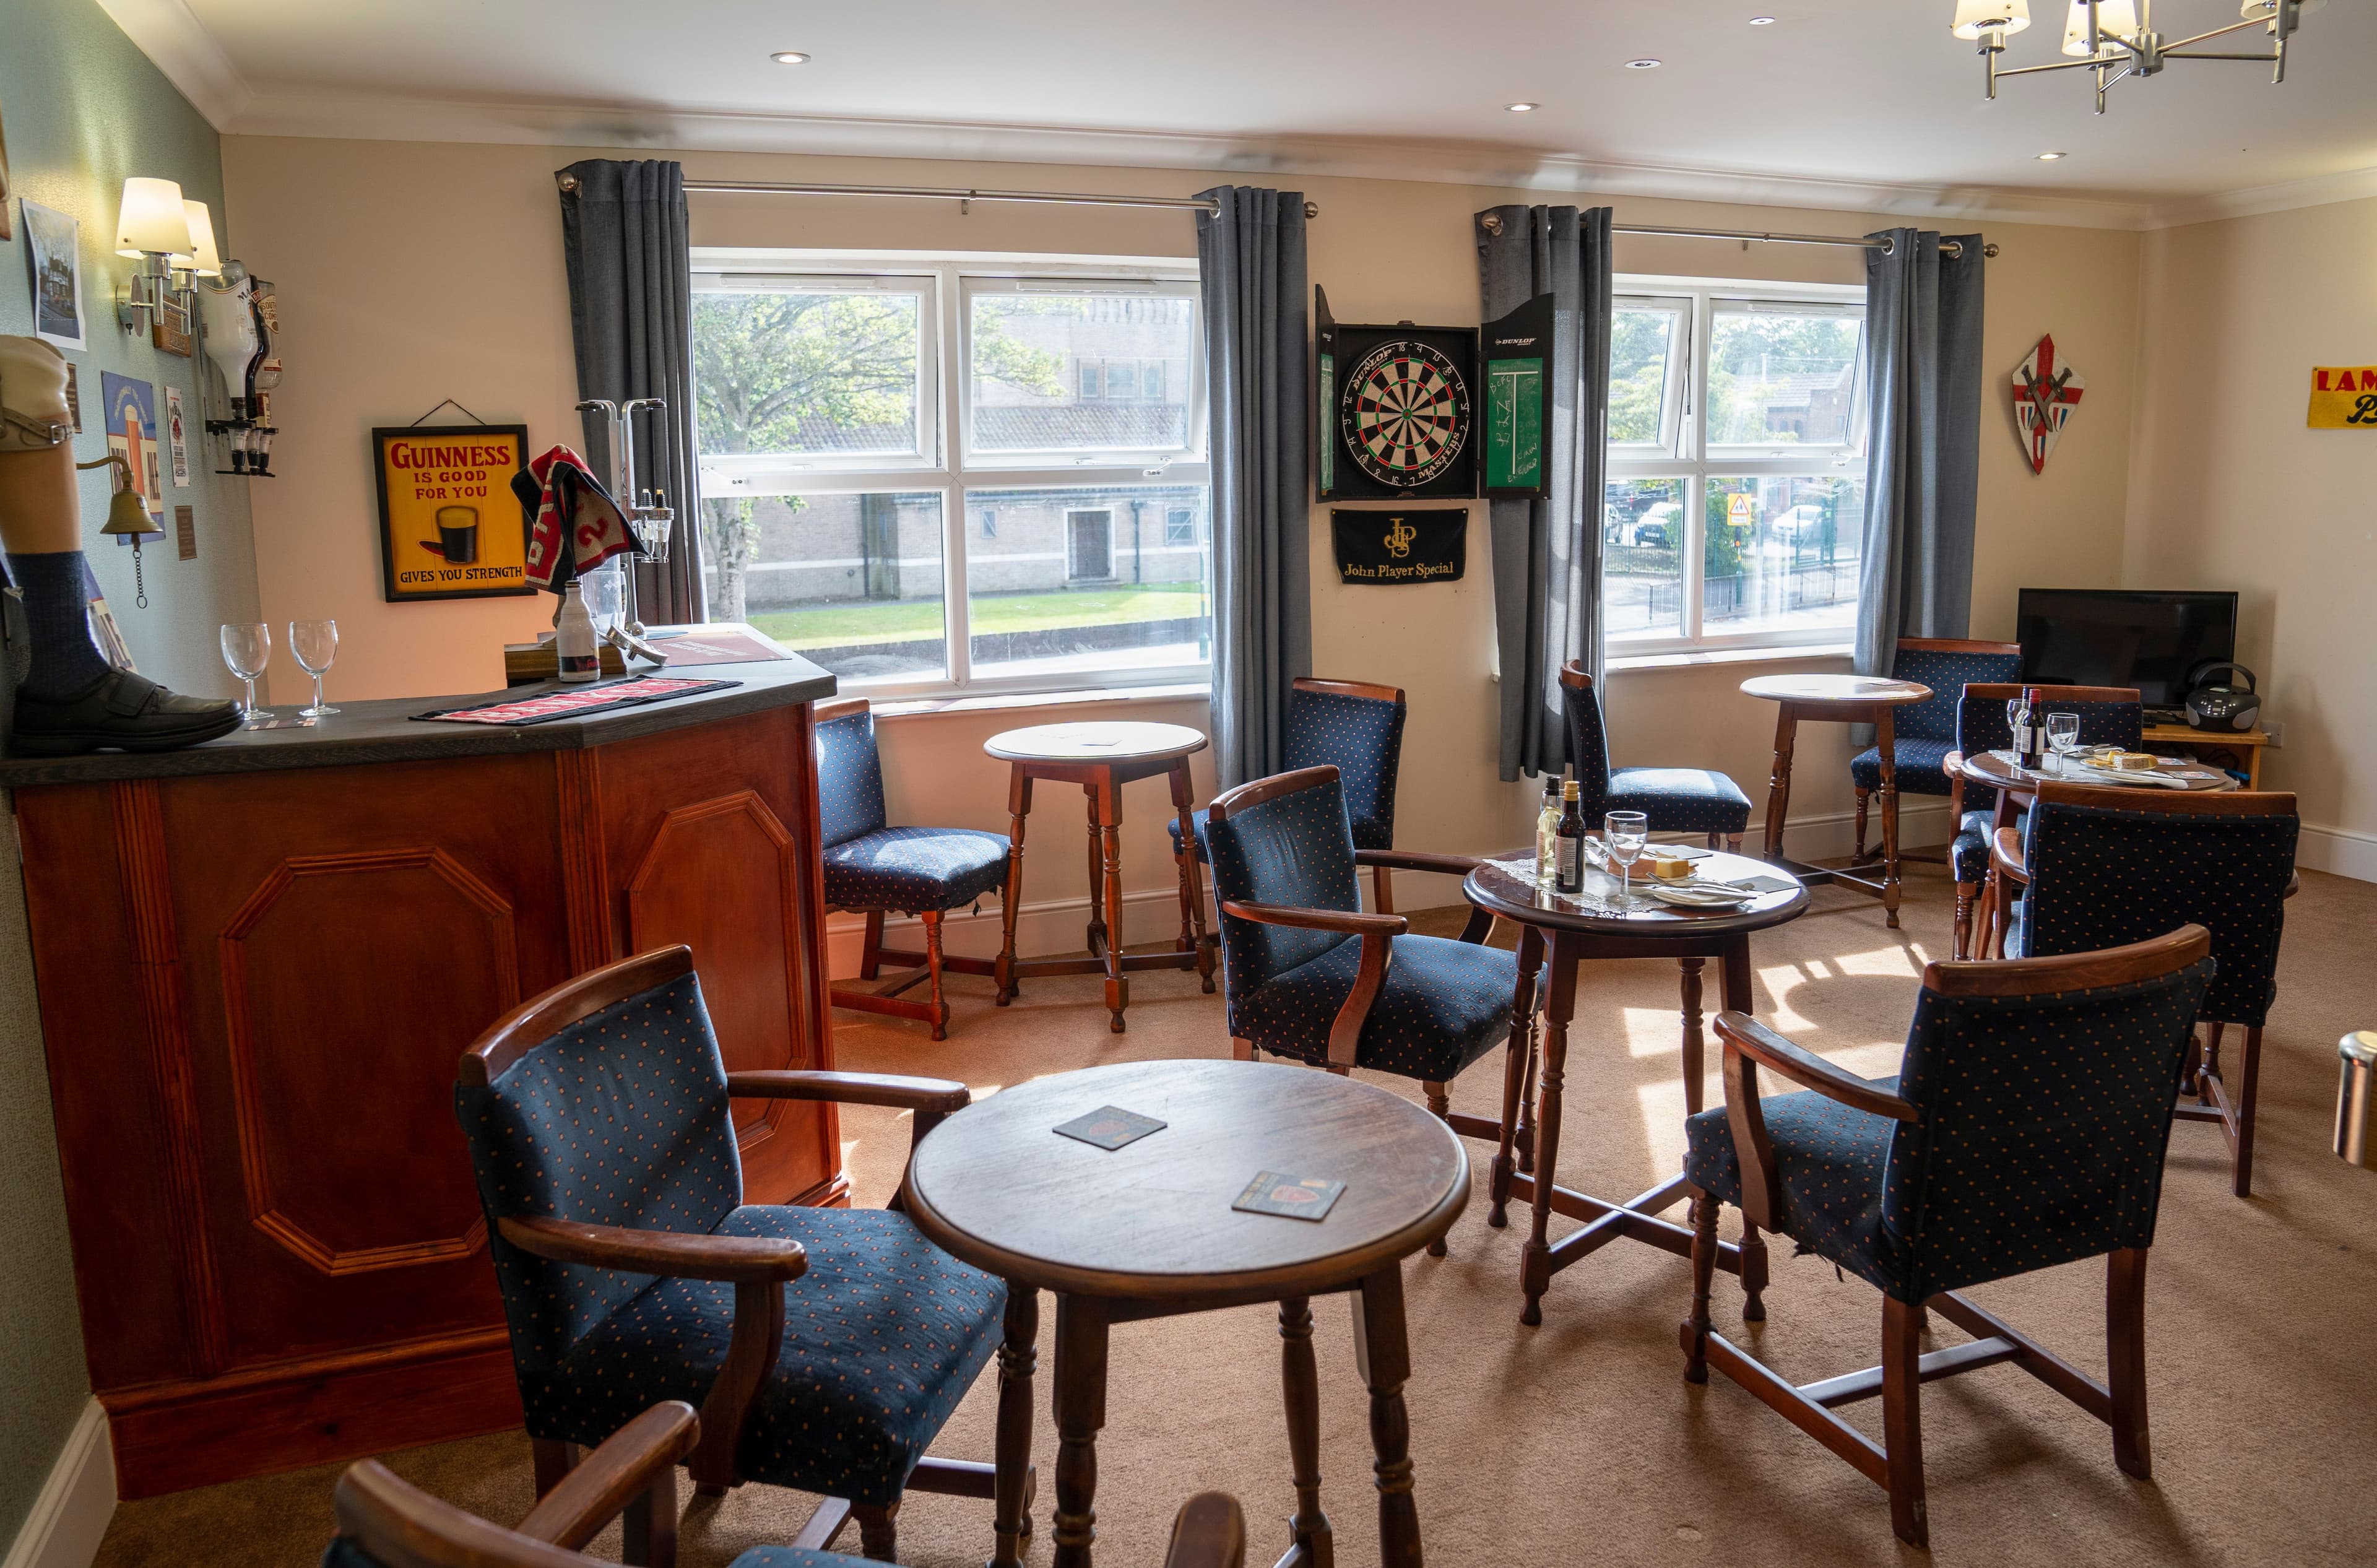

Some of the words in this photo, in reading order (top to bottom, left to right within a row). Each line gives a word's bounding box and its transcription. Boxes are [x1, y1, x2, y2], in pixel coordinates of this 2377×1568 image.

[1399, 342, 1406, 352] 18
[1416, 344, 1423, 353] 4
[1432, 352, 1442, 362] 13
[1353, 349, 1392, 391] DUNLOP
[2317, 370, 2377, 391] LAM
[2346, 394, 2377, 424] P
[391, 443, 511, 470] GUINNESS
[1418, 431, 1460, 479] MASTERS
[413, 472, 433, 483] IS
[439, 470, 487, 483] GOOD
[1374, 469, 1381, 477] 8
[1392, 476, 1400, 485] 16
[1409, 477, 1415, 485] 7
[415, 488, 448, 500] FOR
[452, 486, 487, 499] YOU
[400, 570, 435, 583] GIVES
[438, 568, 462, 581] YOU
[465, 566, 522, 580] STRENGTH
[1344, 563, 1375, 577] John
[1377, 565, 1414, 579] Player
[1416, 561, 1454, 579] Special
